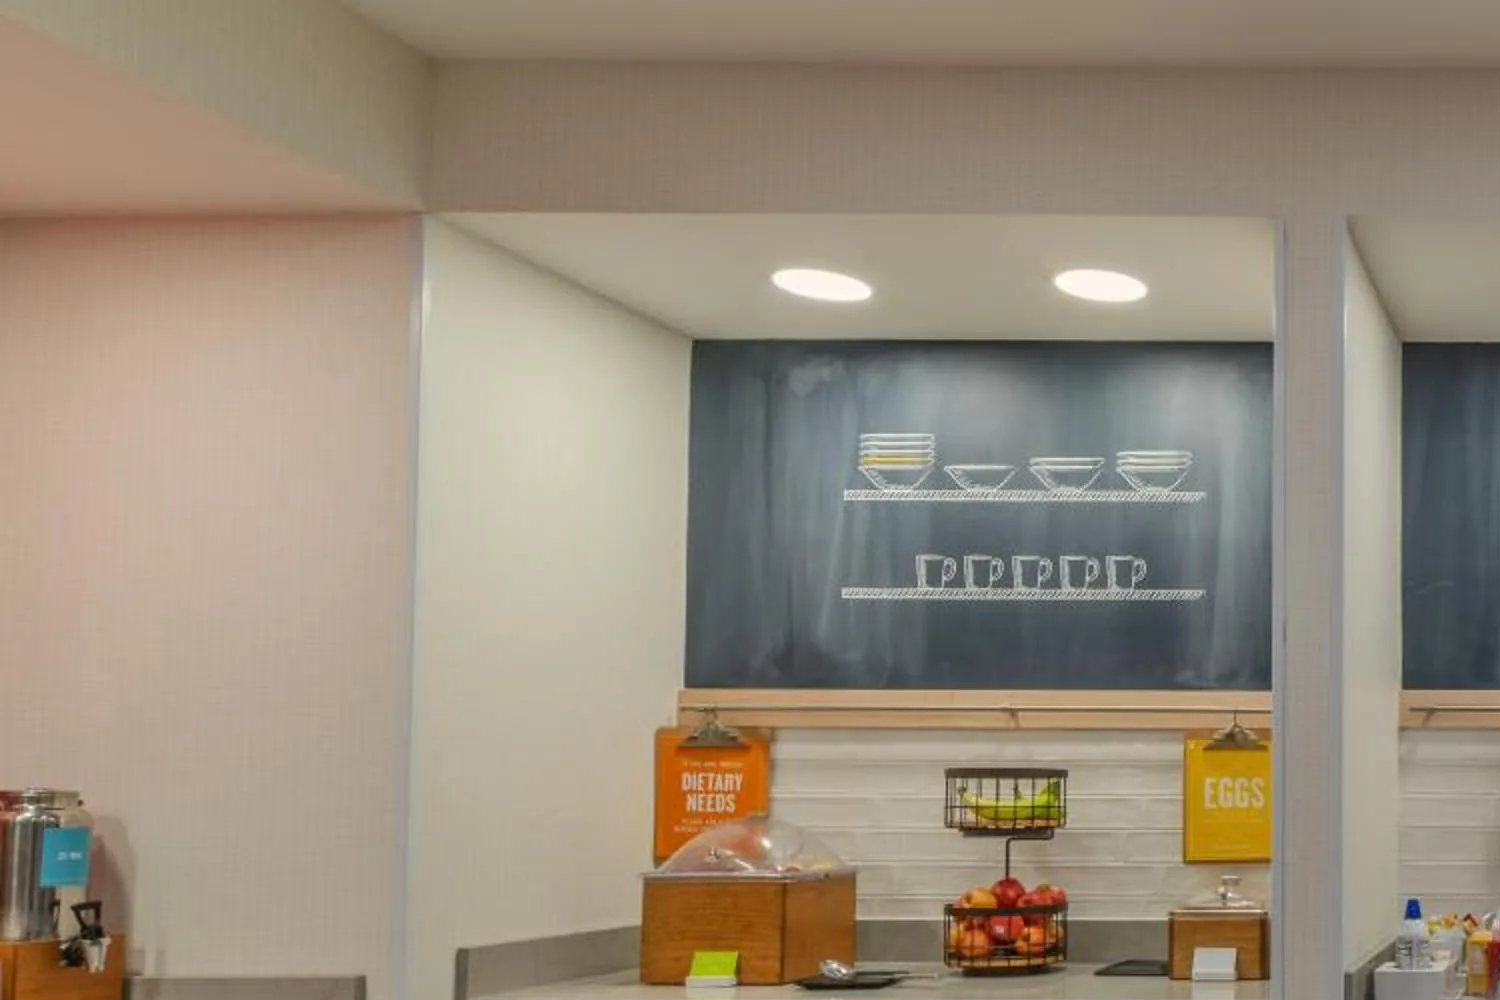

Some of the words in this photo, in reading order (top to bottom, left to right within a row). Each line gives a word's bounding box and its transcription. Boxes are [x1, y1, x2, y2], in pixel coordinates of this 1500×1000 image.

[682, 772, 743, 792] DIETARY
[686, 793, 736, 812] NEEDS
[1204, 777, 1265, 809] EGGS
